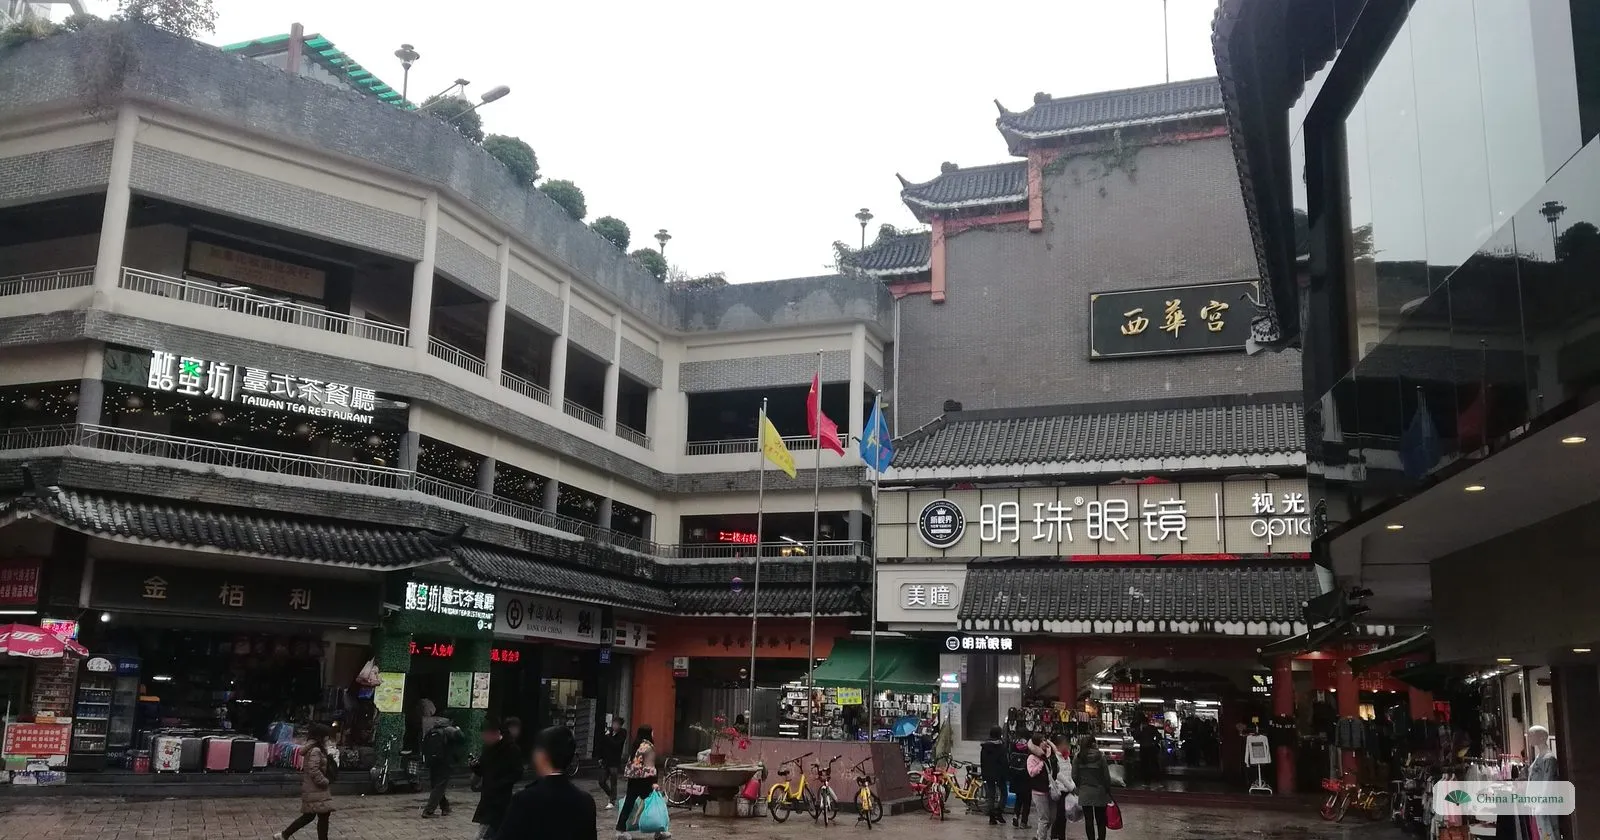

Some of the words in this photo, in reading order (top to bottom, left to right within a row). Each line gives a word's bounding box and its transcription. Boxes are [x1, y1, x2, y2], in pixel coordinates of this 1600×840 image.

[241, 394, 284, 411] TAIWAN
[285, 401, 306, 413] TEA
[307, 406, 374, 425] RESTAURANT
[1251, 492, 1305, 513] 视光
[907, 585, 950, 606] 美瞳
[527, 623, 540, 632] BANK
[547, 626, 563, 635] CHINA
